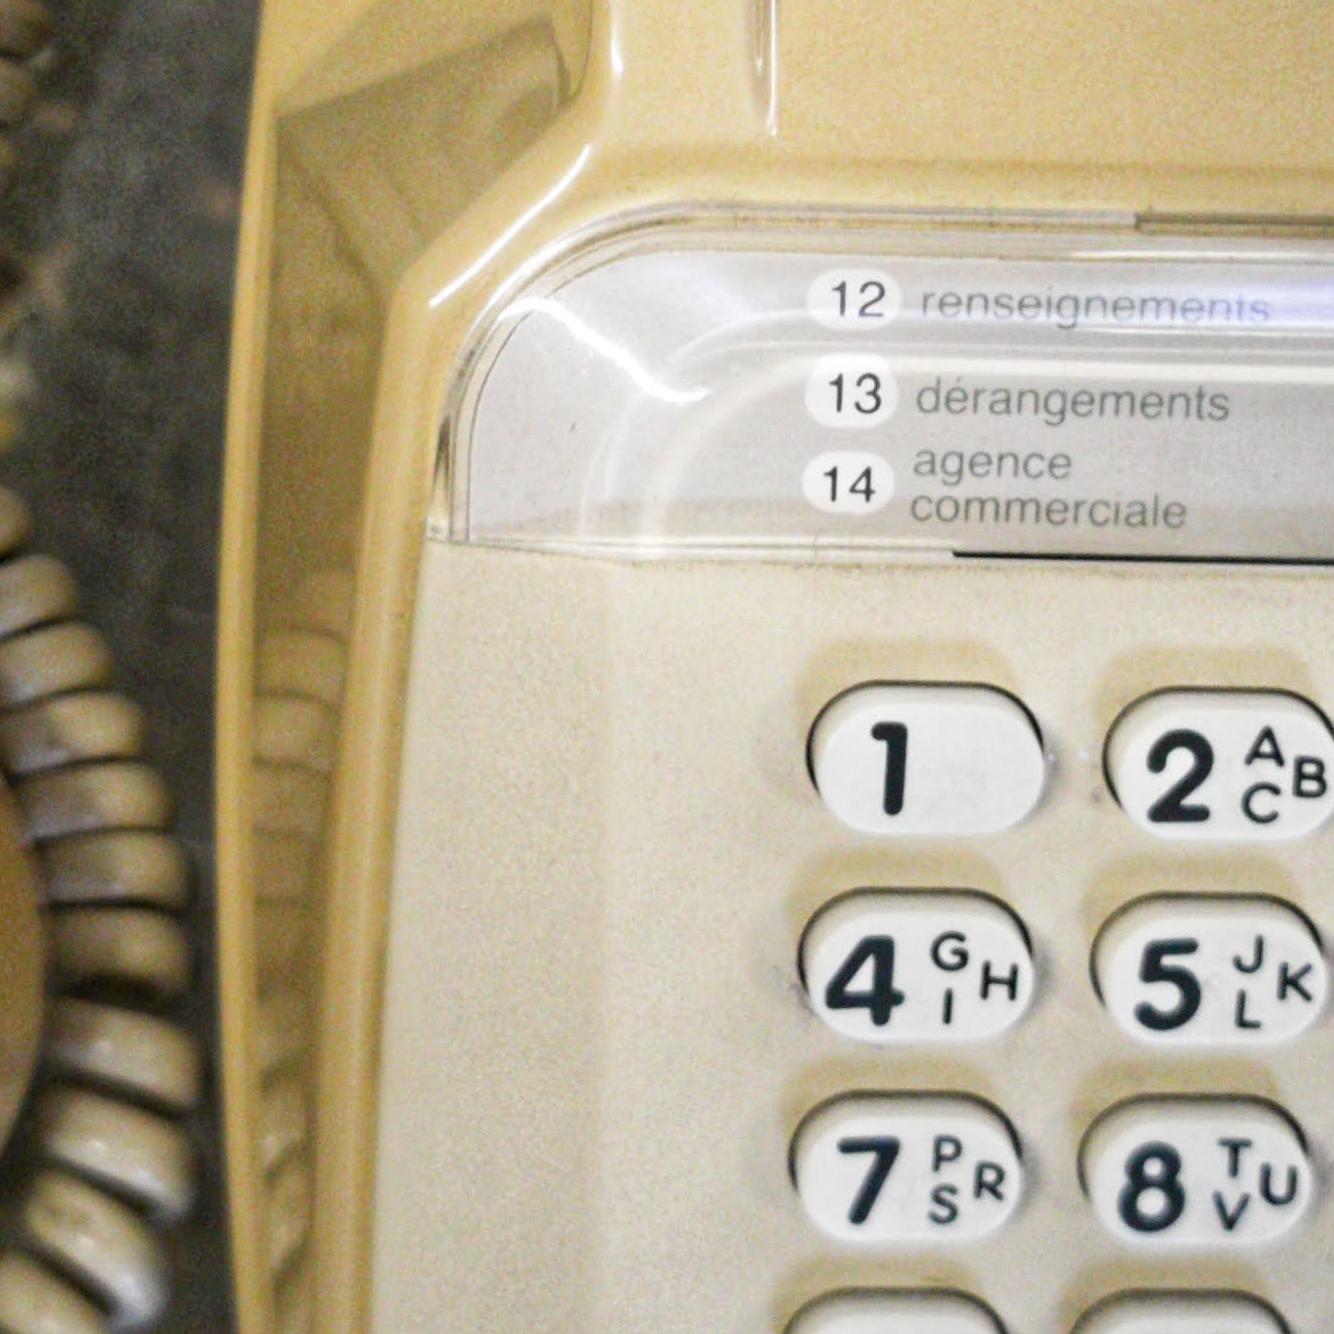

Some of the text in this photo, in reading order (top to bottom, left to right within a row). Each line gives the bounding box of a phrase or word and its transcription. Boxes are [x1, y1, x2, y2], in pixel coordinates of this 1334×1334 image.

[830, 280, 1270, 329] 12 renseignements
[828, 372, 1231, 426] 13 dérangements
[822, 446, 1073, 504] 14 agence
[909, 493, 1187, 529] commerciale
[869, 720, 910, 818] 1
[1145, 727, 1216, 825] 2
[823, 934, 907, 1029] 4
[1133, 936, 1204, 1034] 5
[836, 1135, 903, 1227] 7
[1116, 1141, 1188, 1236] 8
